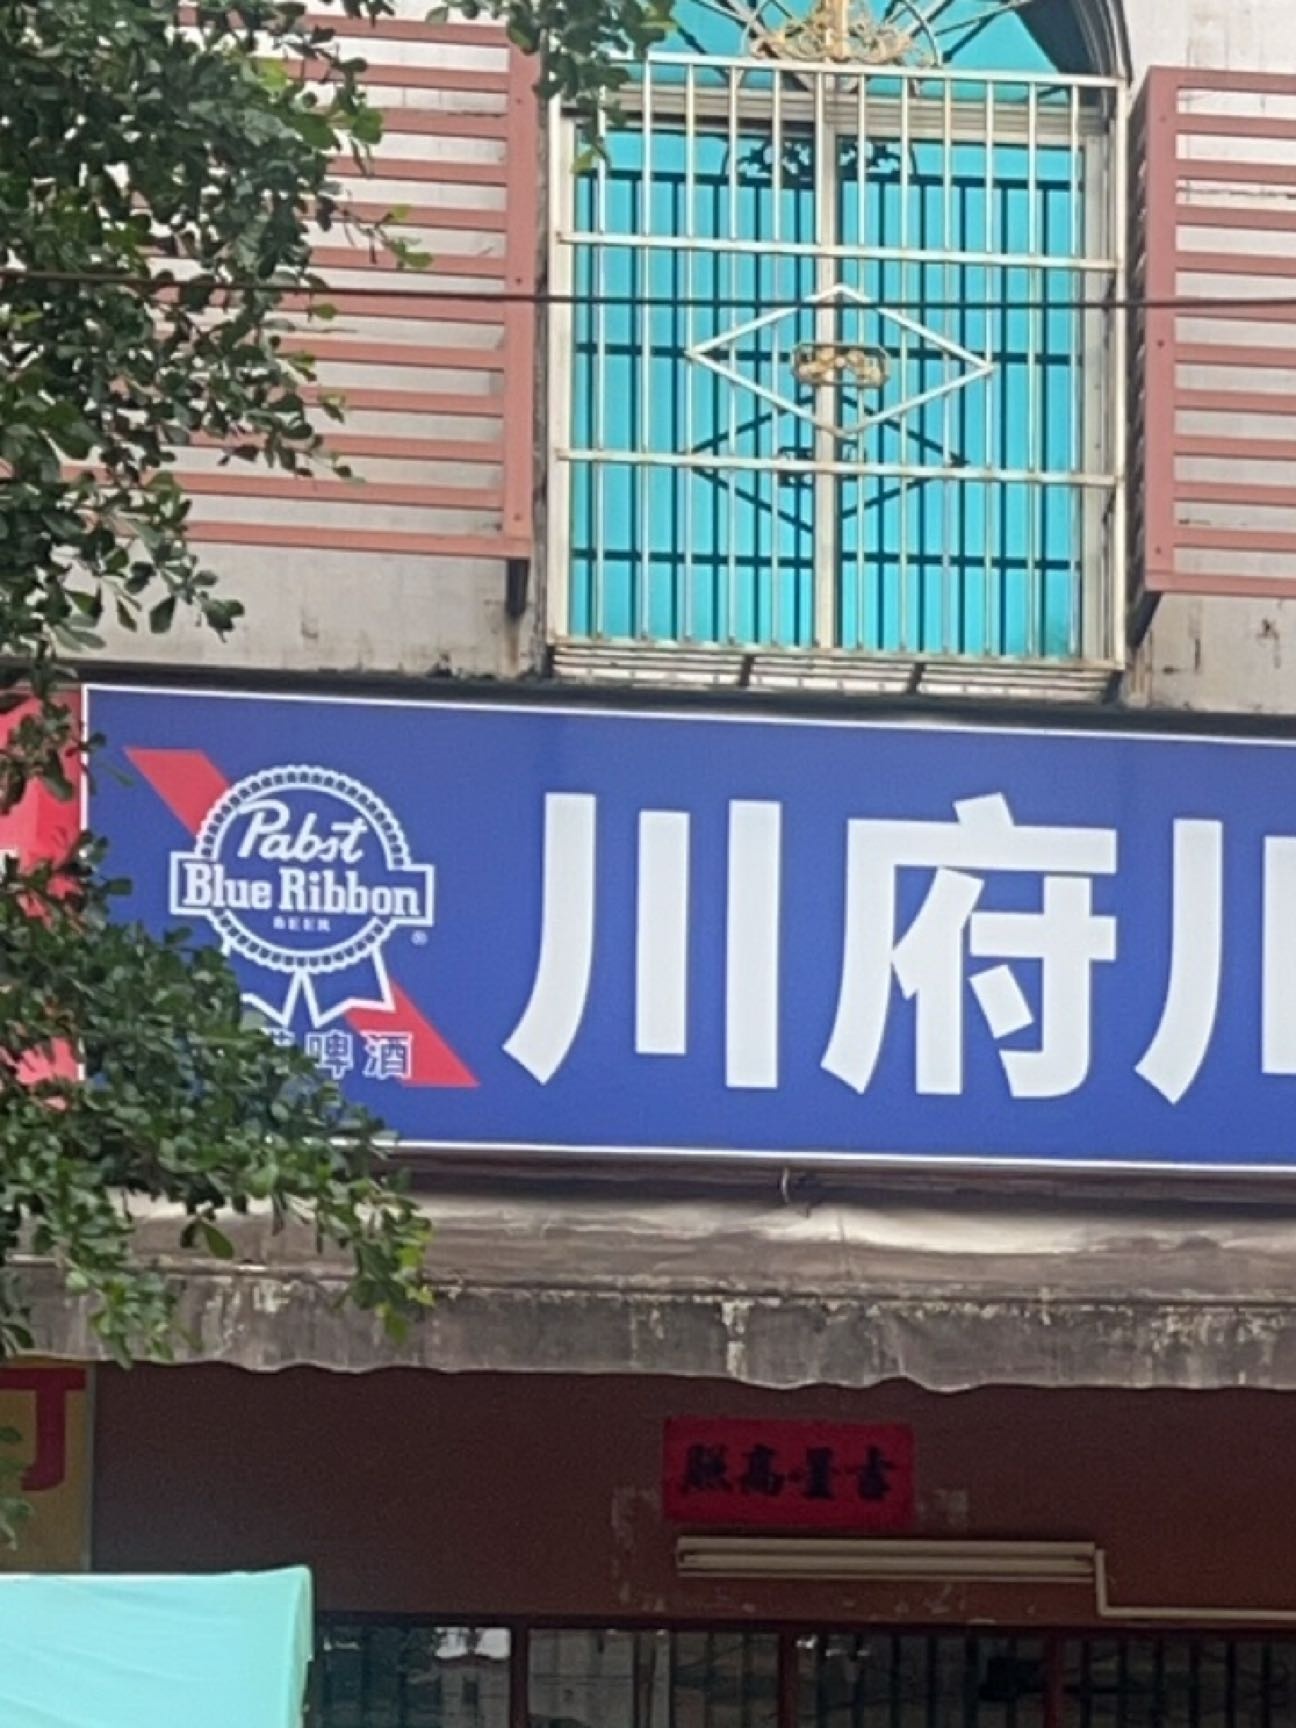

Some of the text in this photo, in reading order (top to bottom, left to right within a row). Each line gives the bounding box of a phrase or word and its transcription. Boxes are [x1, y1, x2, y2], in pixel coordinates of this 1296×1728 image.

[237, 799, 367, 864] Pabst
[182, 863, 421, 917] Blue Ribbon
[273, 916, 332, 932] BEER
